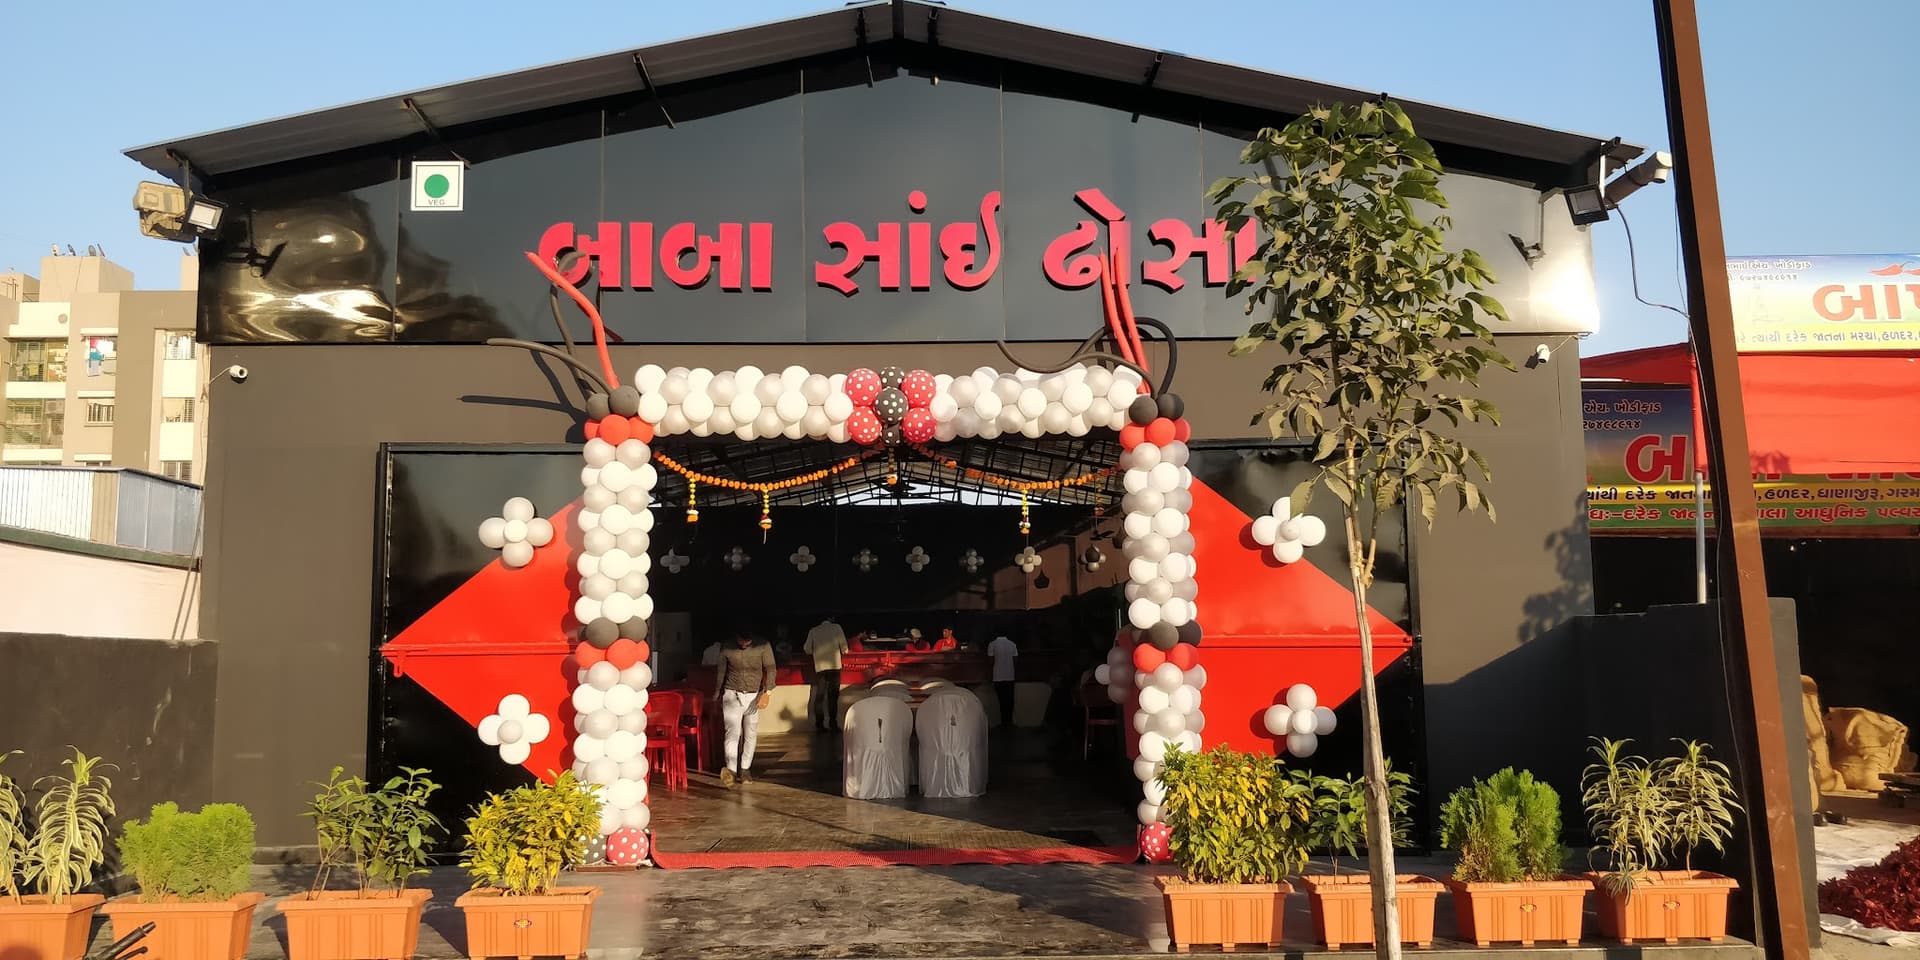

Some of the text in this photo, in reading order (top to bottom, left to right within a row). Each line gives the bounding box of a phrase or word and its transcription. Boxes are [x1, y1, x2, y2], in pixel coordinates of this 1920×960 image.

[539, 187, 1257, 295] બાબા સાંઈ ઢોસા
[1625, 486, 1657, 500] દરેક
